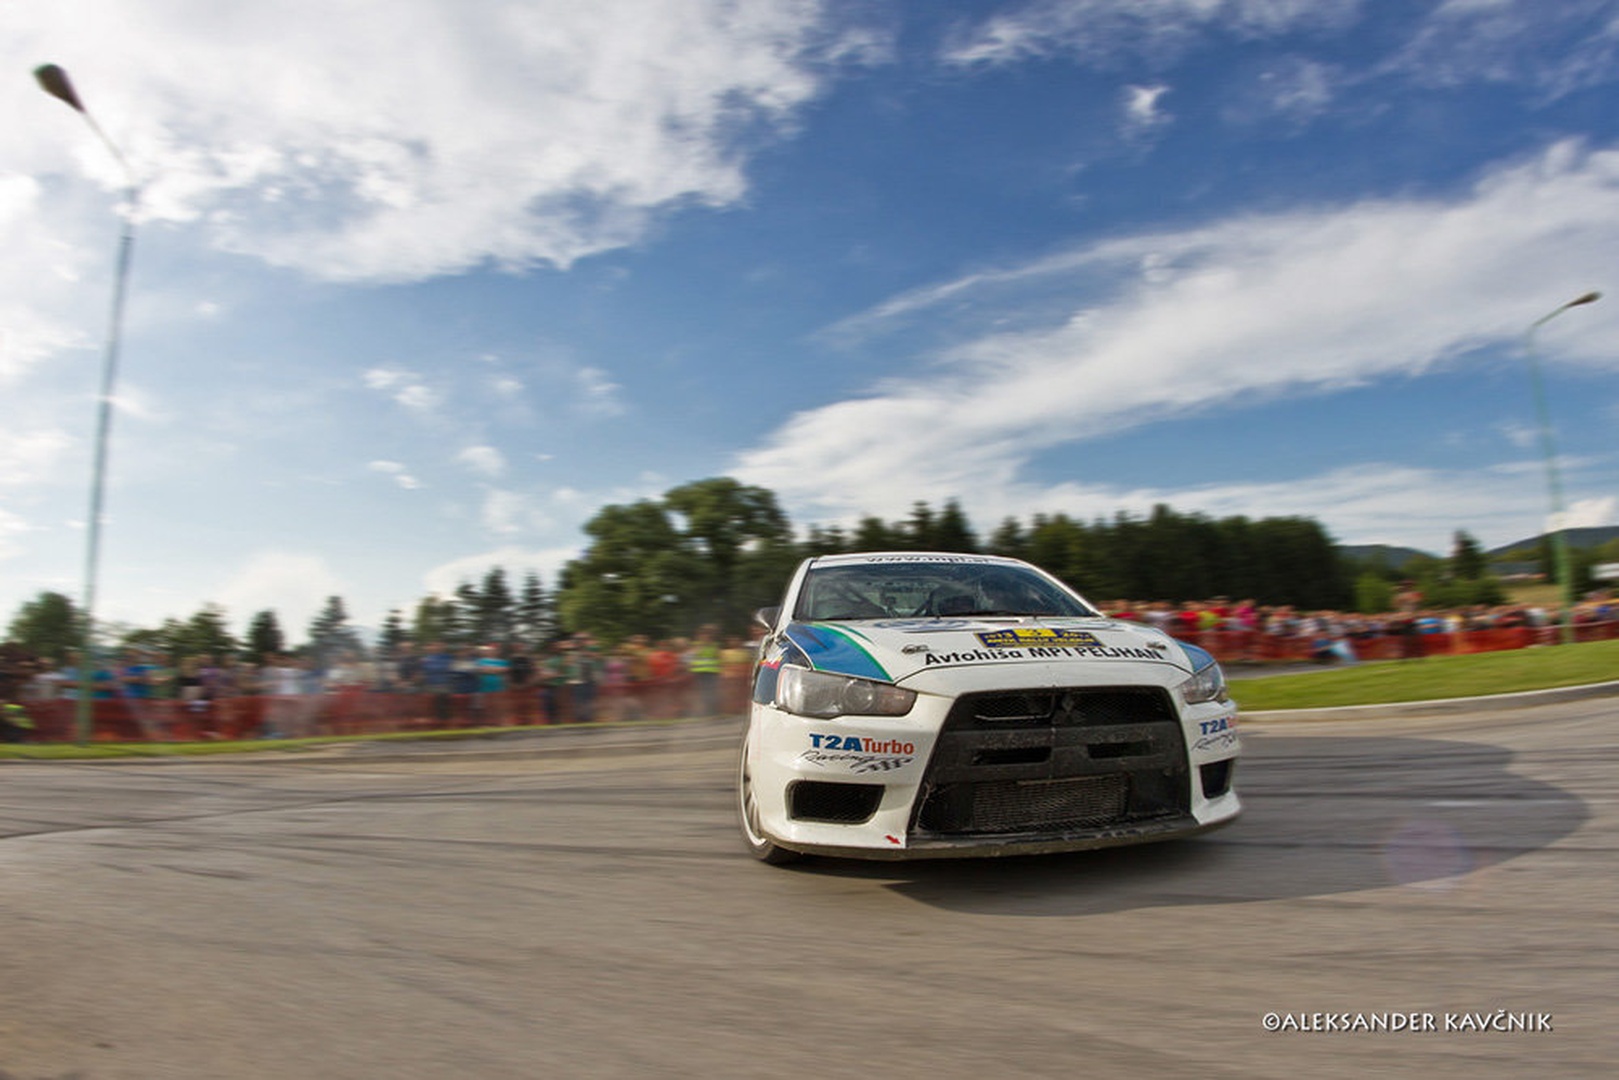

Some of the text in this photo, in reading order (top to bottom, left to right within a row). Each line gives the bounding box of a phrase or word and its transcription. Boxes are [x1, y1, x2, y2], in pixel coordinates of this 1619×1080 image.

[924, 647, 1165, 666] Avtohiša MPI PELJHAN
